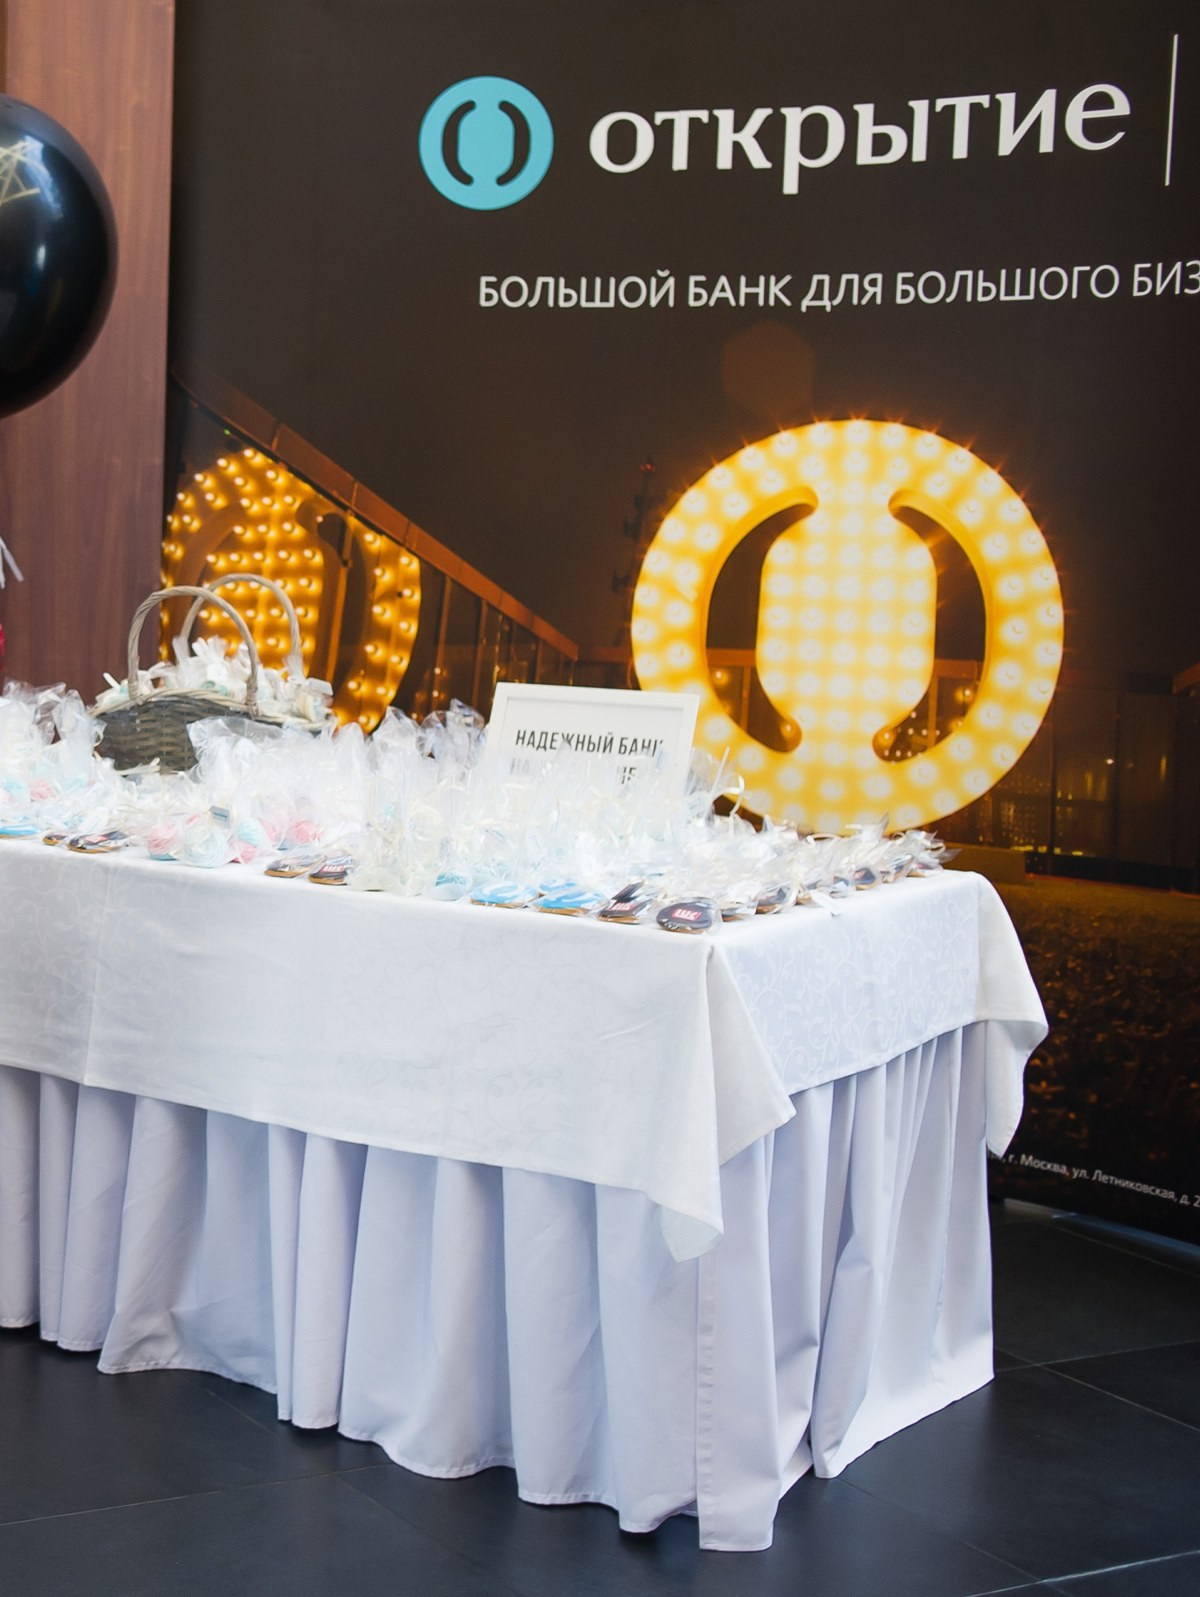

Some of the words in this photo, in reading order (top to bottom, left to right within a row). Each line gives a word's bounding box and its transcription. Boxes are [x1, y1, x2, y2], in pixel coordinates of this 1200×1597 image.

[589, 83, 1131, 195] открытие
[479, 269, 676, 309] БОЛЬШОЙ
[687, 274, 793, 307] БАНК
[800, 272, 883, 313] ДЛЯ
[895, 264, 1120, 305] БОЛЬШОГО
[1132, 259, 1200, 297] БИЗ
[515, 729, 614, 754] НАДЕЖНЫЙ
[1020, 1154, 1070, 1176] Москва,
[1072, 1168, 1090, 1179] ул.
[1092, 1169, 1178, 1202] Летниковская,
